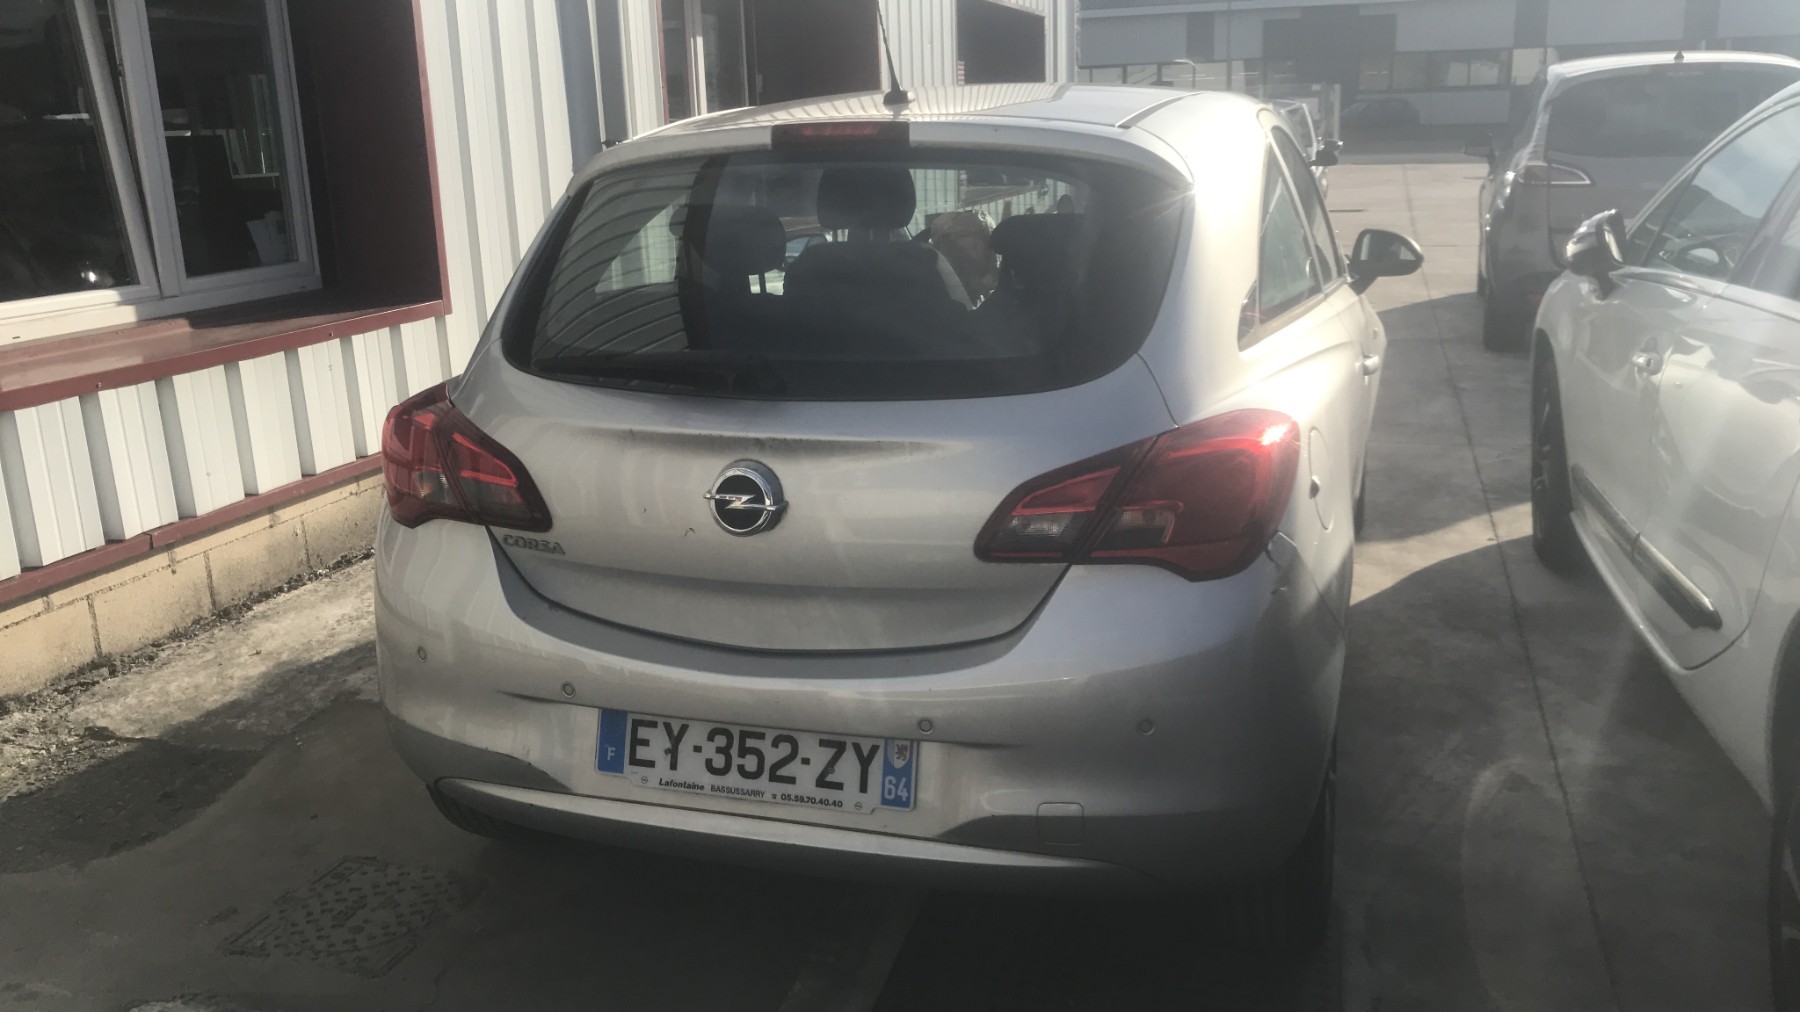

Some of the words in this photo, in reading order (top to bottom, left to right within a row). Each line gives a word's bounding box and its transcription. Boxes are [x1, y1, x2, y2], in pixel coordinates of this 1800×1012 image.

[503, 534, 566, 555] CORSA
[606, 747, 616, 761] F
[628, 718, 881, 794] EY-352-ZY
[658, 777, 705, 791] Lafontaine
[710, 784, 765, 799] BASSUSSARRY
[780, 793, 843, 808] 05.59.70.40.40
[884, 776, 909, 802] 64
